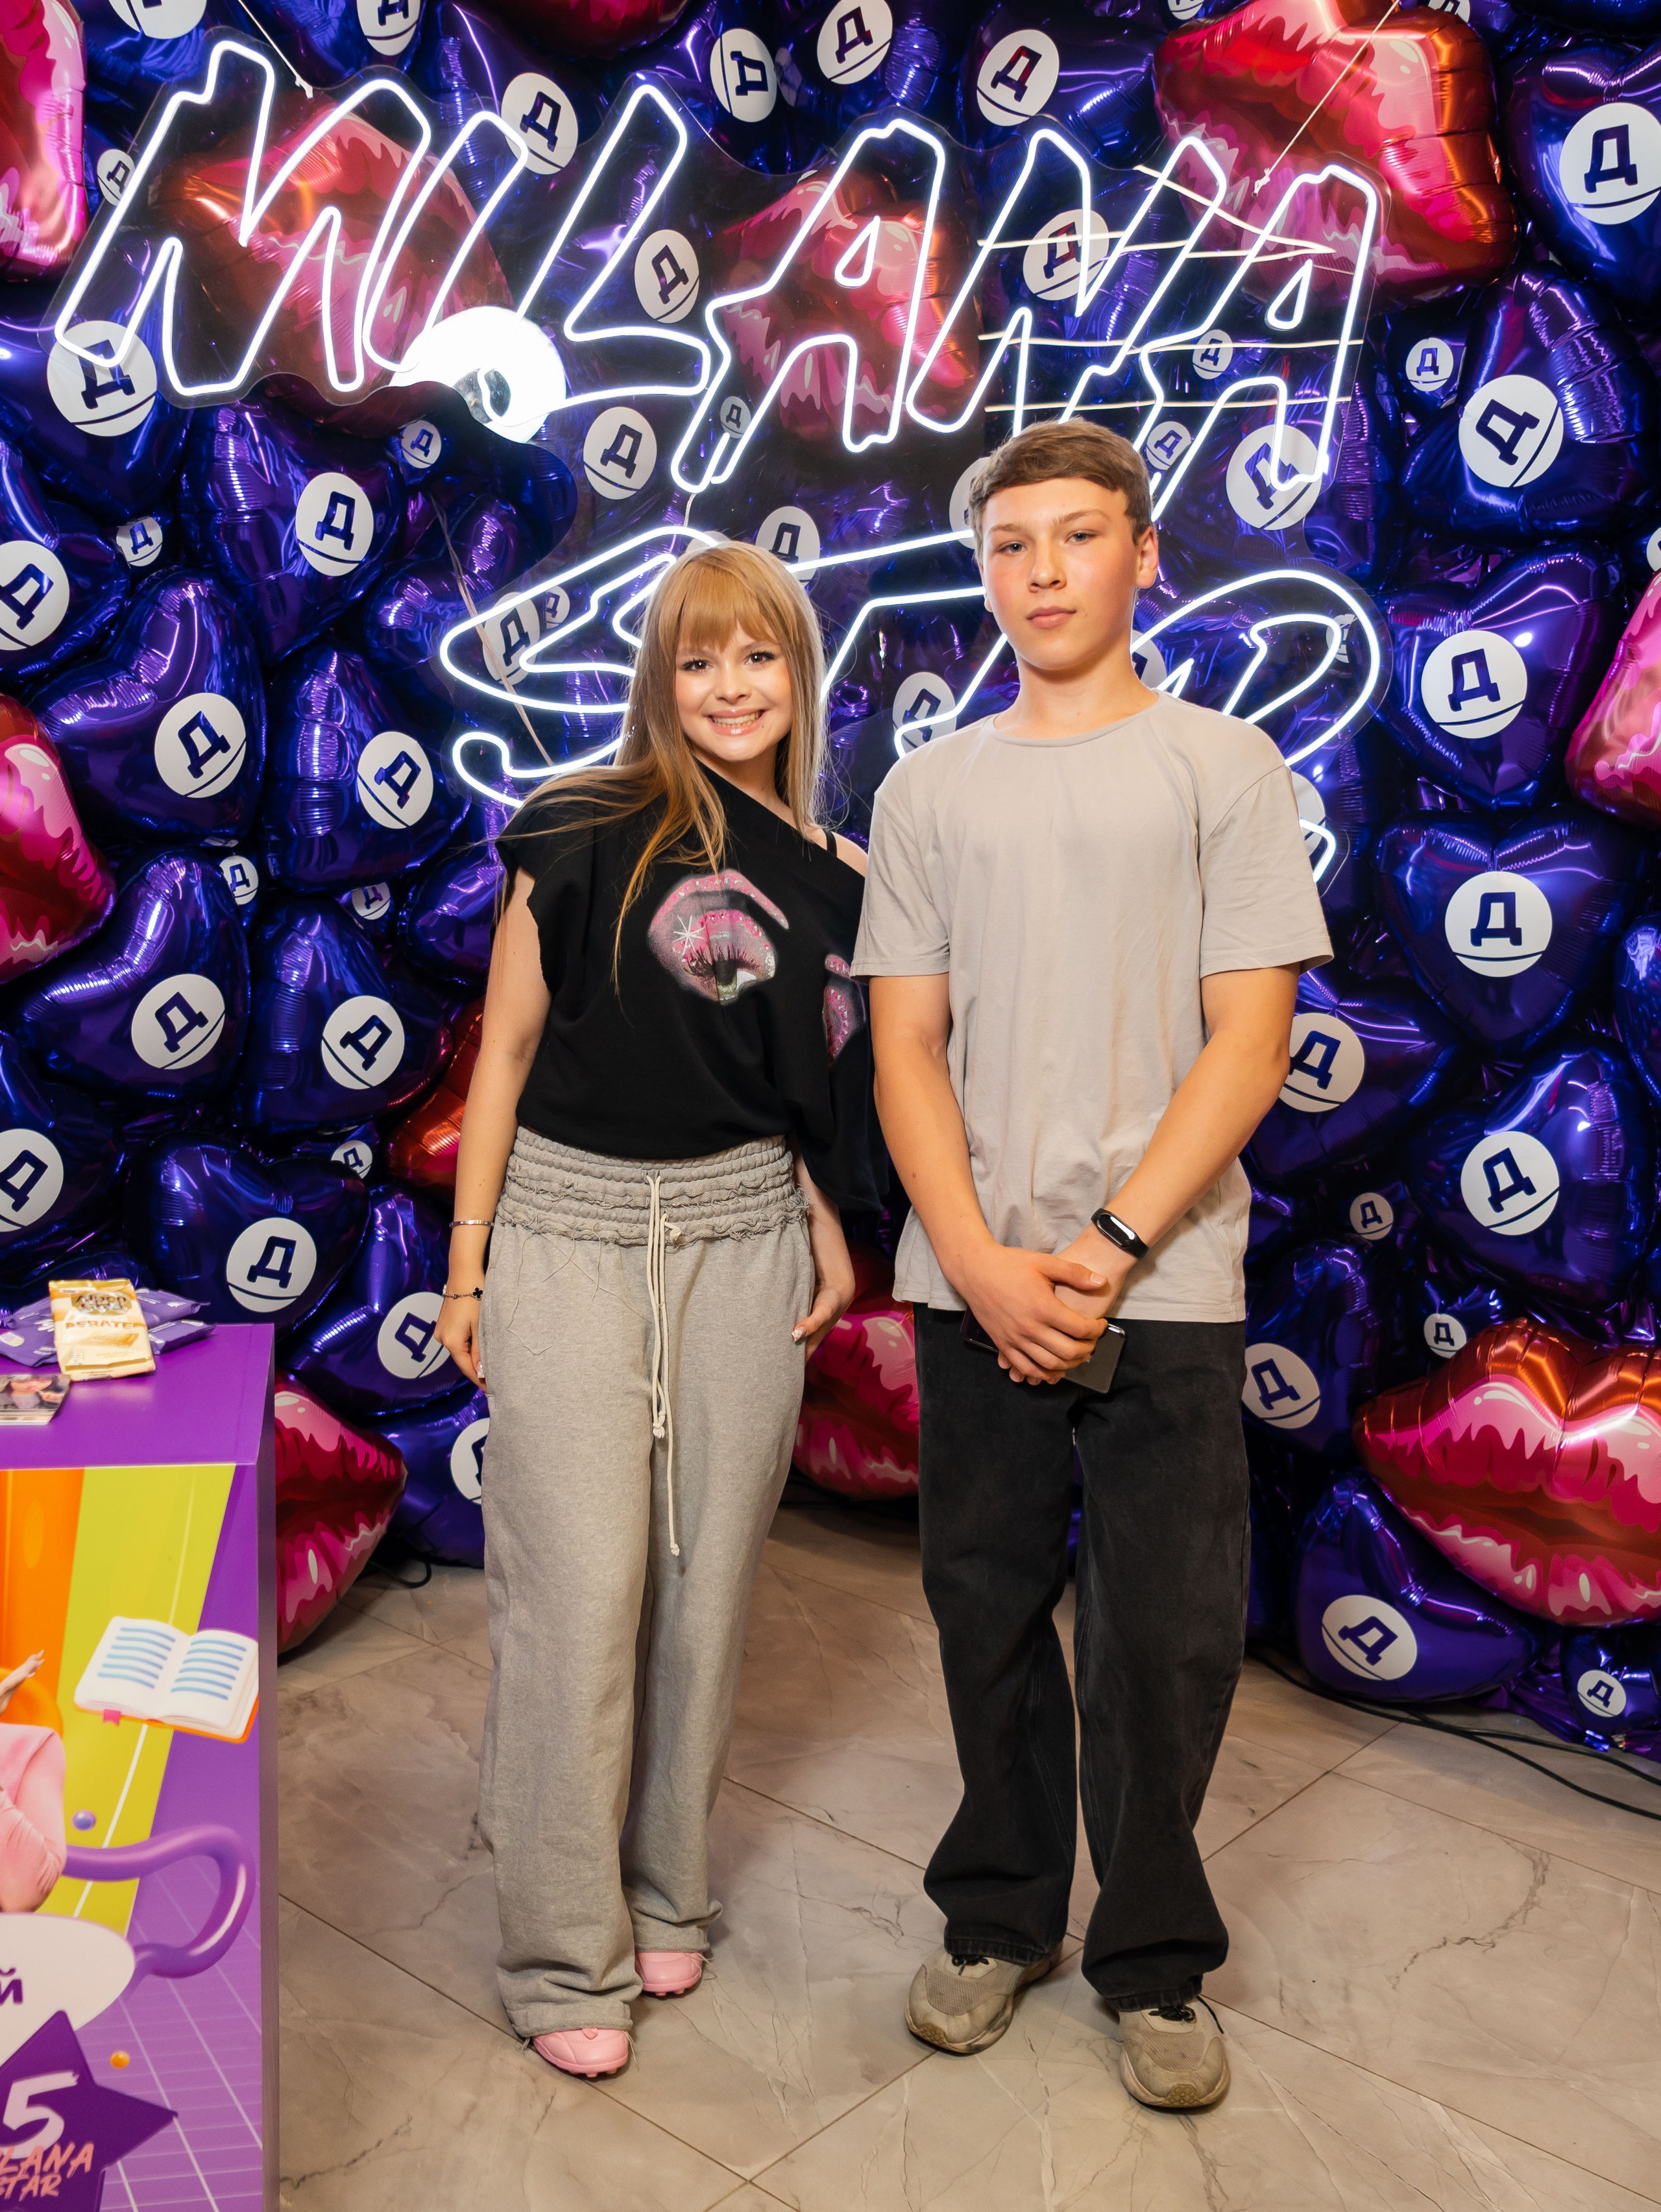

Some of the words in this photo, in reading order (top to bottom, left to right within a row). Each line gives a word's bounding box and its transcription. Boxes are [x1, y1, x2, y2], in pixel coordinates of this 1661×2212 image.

[836, 6, 873, 64] Д
[731, 51, 768, 95] Д
[991, 45, 1042, 102] Д
[520, 91, 561, 152] Д
[1584, 125, 1638, 193] Д
[652, 245, 688, 304] Д
[1043, 222, 1082, 279] Д
[55, 40, 1377, 519] MILANA
[79, 339, 136, 409] Д
[1200, 339, 1220, 367] Д
[1416, 348, 1438, 376] Д
[410, 429, 433, 457] Д
[726, 404, 742, 428] Д
[1476, 400, 1540, 465] Д
[600, 424, 642, 479] Д
[1154, 430, 1182, 459] Д
[130, 523, 154, 555] Д
[315, 492, 355, 551] Д
[0, 564, 53, 630] Д
[546, 592, 560, 618] Д
[500, 608, 530, 666] Д
[1448, 649, 1500, 712] Д
[178, 711, 230, 778] Д
[374, 751, 421, 809] Д
[230, 865, 250, 891] Д
[363, 885, 383, 908] Д
[1470, 892, 1522, 946] Д
[155, 992, 208, 1053] Д
[340, 1015, 392, 1071] Д
[1290, 1029, 1340, 1090] Д
[0, 1150, 48, 1212] Д
[1483, 1148, 1536, 1212] Д
[1360, 1201, 1383, 1229] Д
[247, 1236, 296, 1288] Д
[395, 1312, 437, 1362] Д
[1433, 1322, 1454, 1346] Д
[1251, 1358, 1300, 1410] Д
[1338, 1617, 1398, 1666] Д
[1587, 1680, 1614, 1708] Д
[0, 2141, 95, 2180] LANA
